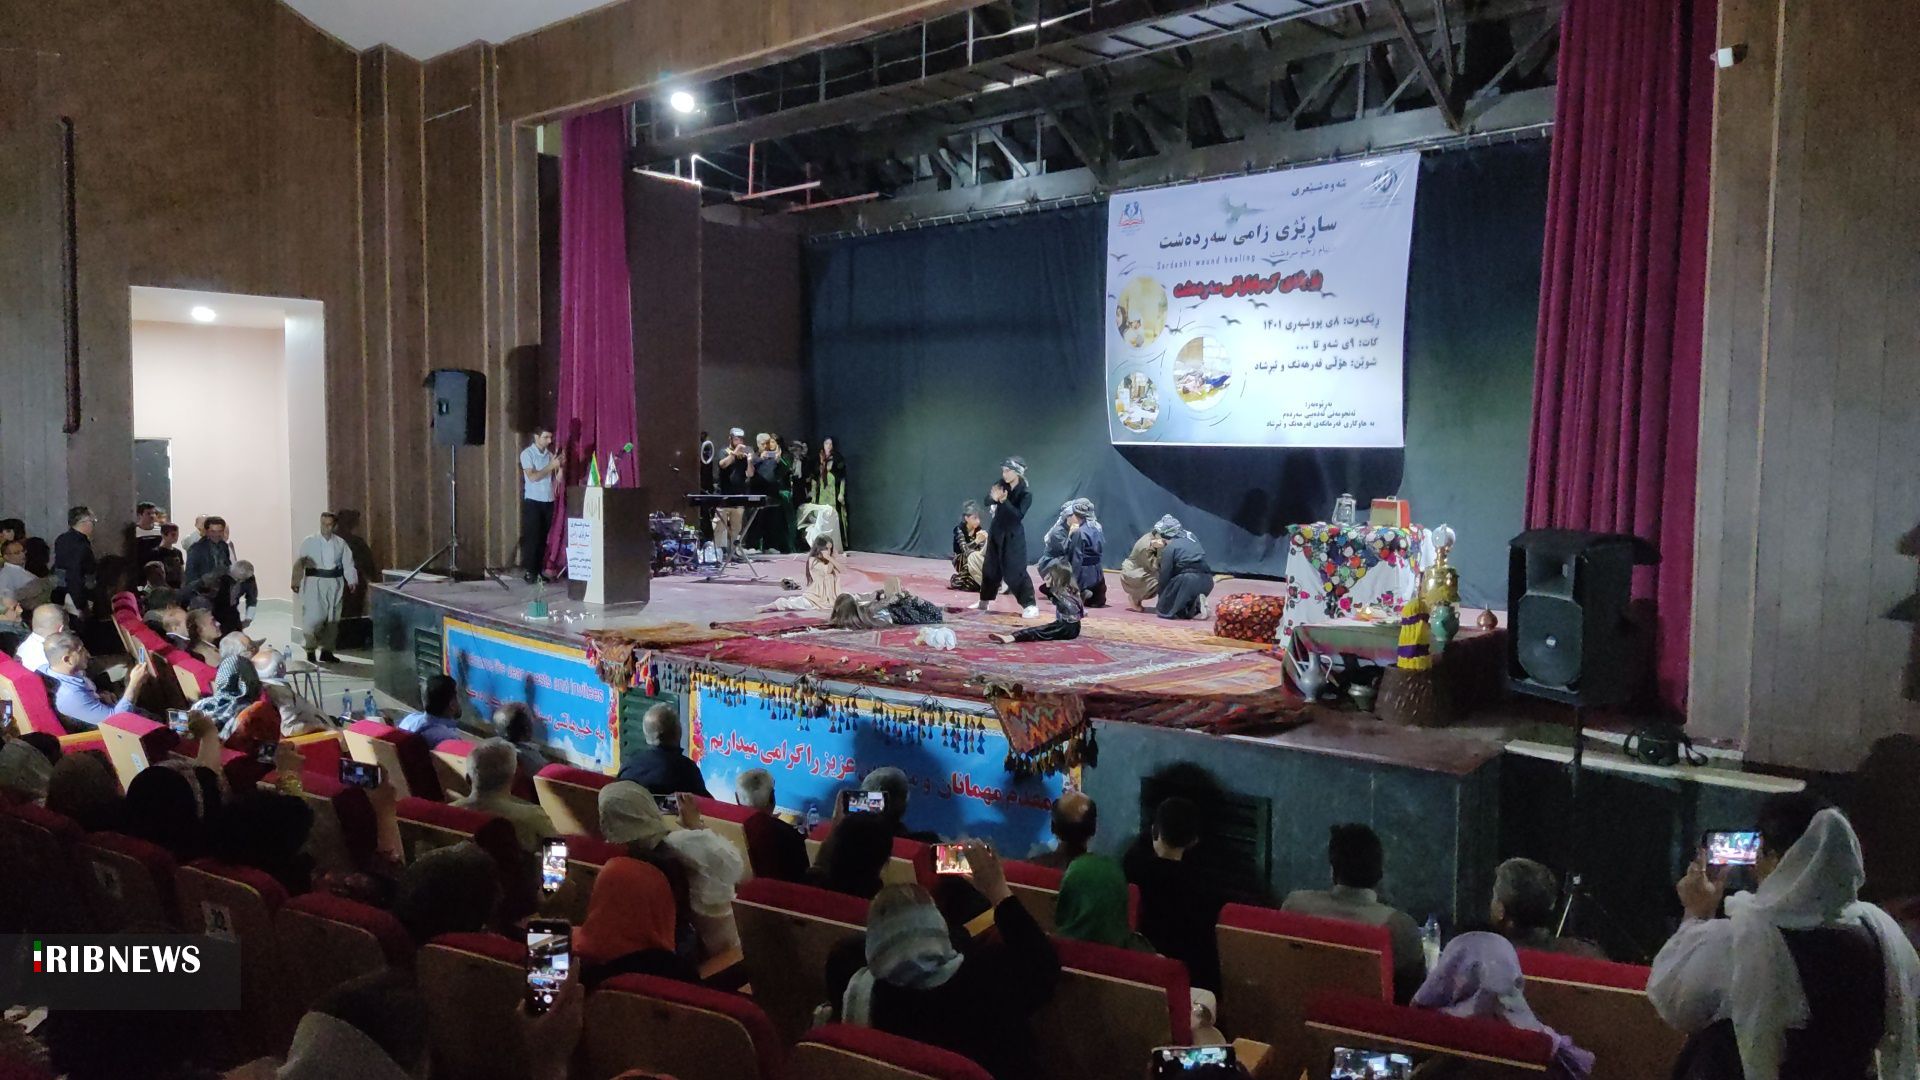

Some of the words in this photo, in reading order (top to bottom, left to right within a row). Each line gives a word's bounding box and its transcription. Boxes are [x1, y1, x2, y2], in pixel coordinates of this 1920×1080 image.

[1159, 231, 1227, 250] سەردەشت
[1233, 222, 1269, 246] زامی
[709, 729, 760, 759] میداریم
[759, 739, 807, 771] گرامی
[821, 751, 857, 781] عزیز
